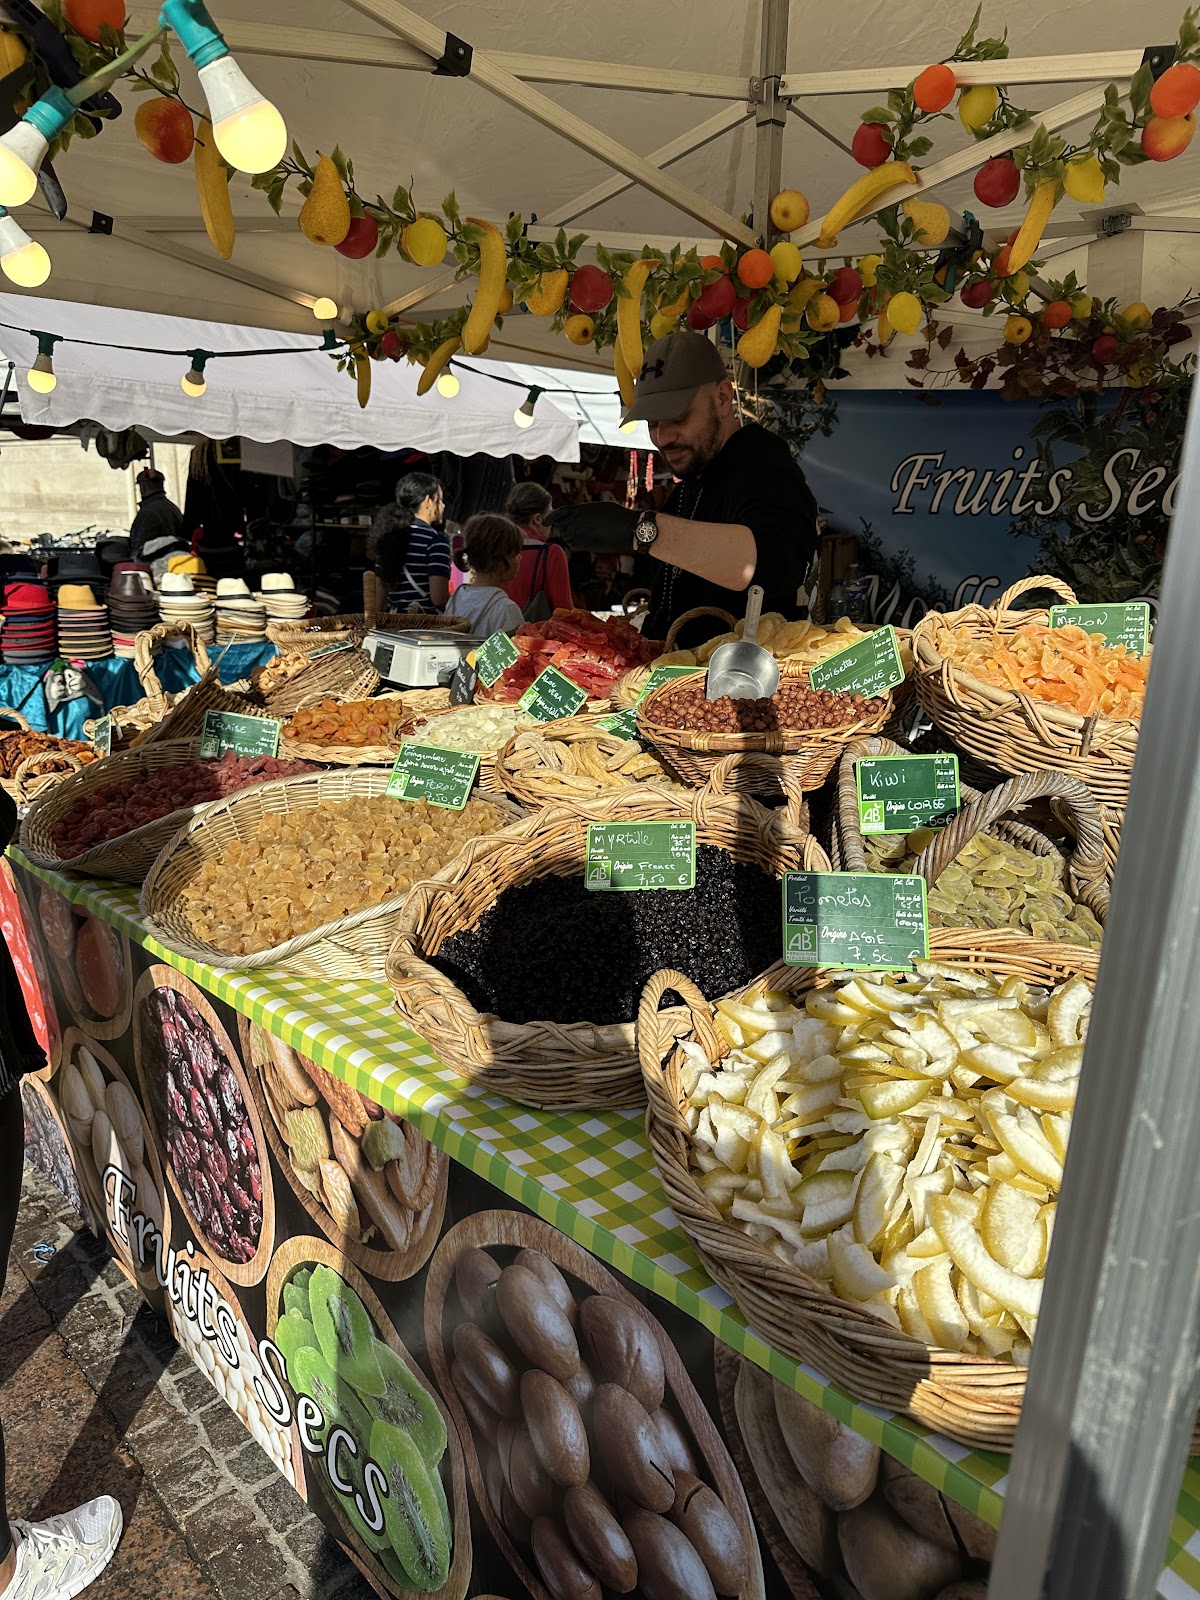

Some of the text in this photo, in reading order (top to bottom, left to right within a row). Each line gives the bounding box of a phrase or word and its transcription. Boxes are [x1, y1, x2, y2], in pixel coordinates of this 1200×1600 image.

[890, 446, 1182, 522] Fruits Sec
[1057, 611, 1108, 626] MELON
[235, 742, 264, 755] FRANCE
[390, 778, 404, 789] AB
[870, 768, 906, 788] Kiwi
[863, 808, 881, 823] AB
[589, 867, 607, 881] AB
[638, 861, 676, 871] France
[678, 873, 688, 885] €
[788, 932, 812, 951] AB
[821, 926, 848, 944] Origine
[848, 946, 893, 963] 7.50
[103, 1164, 390, 1537] Fruits Secs
